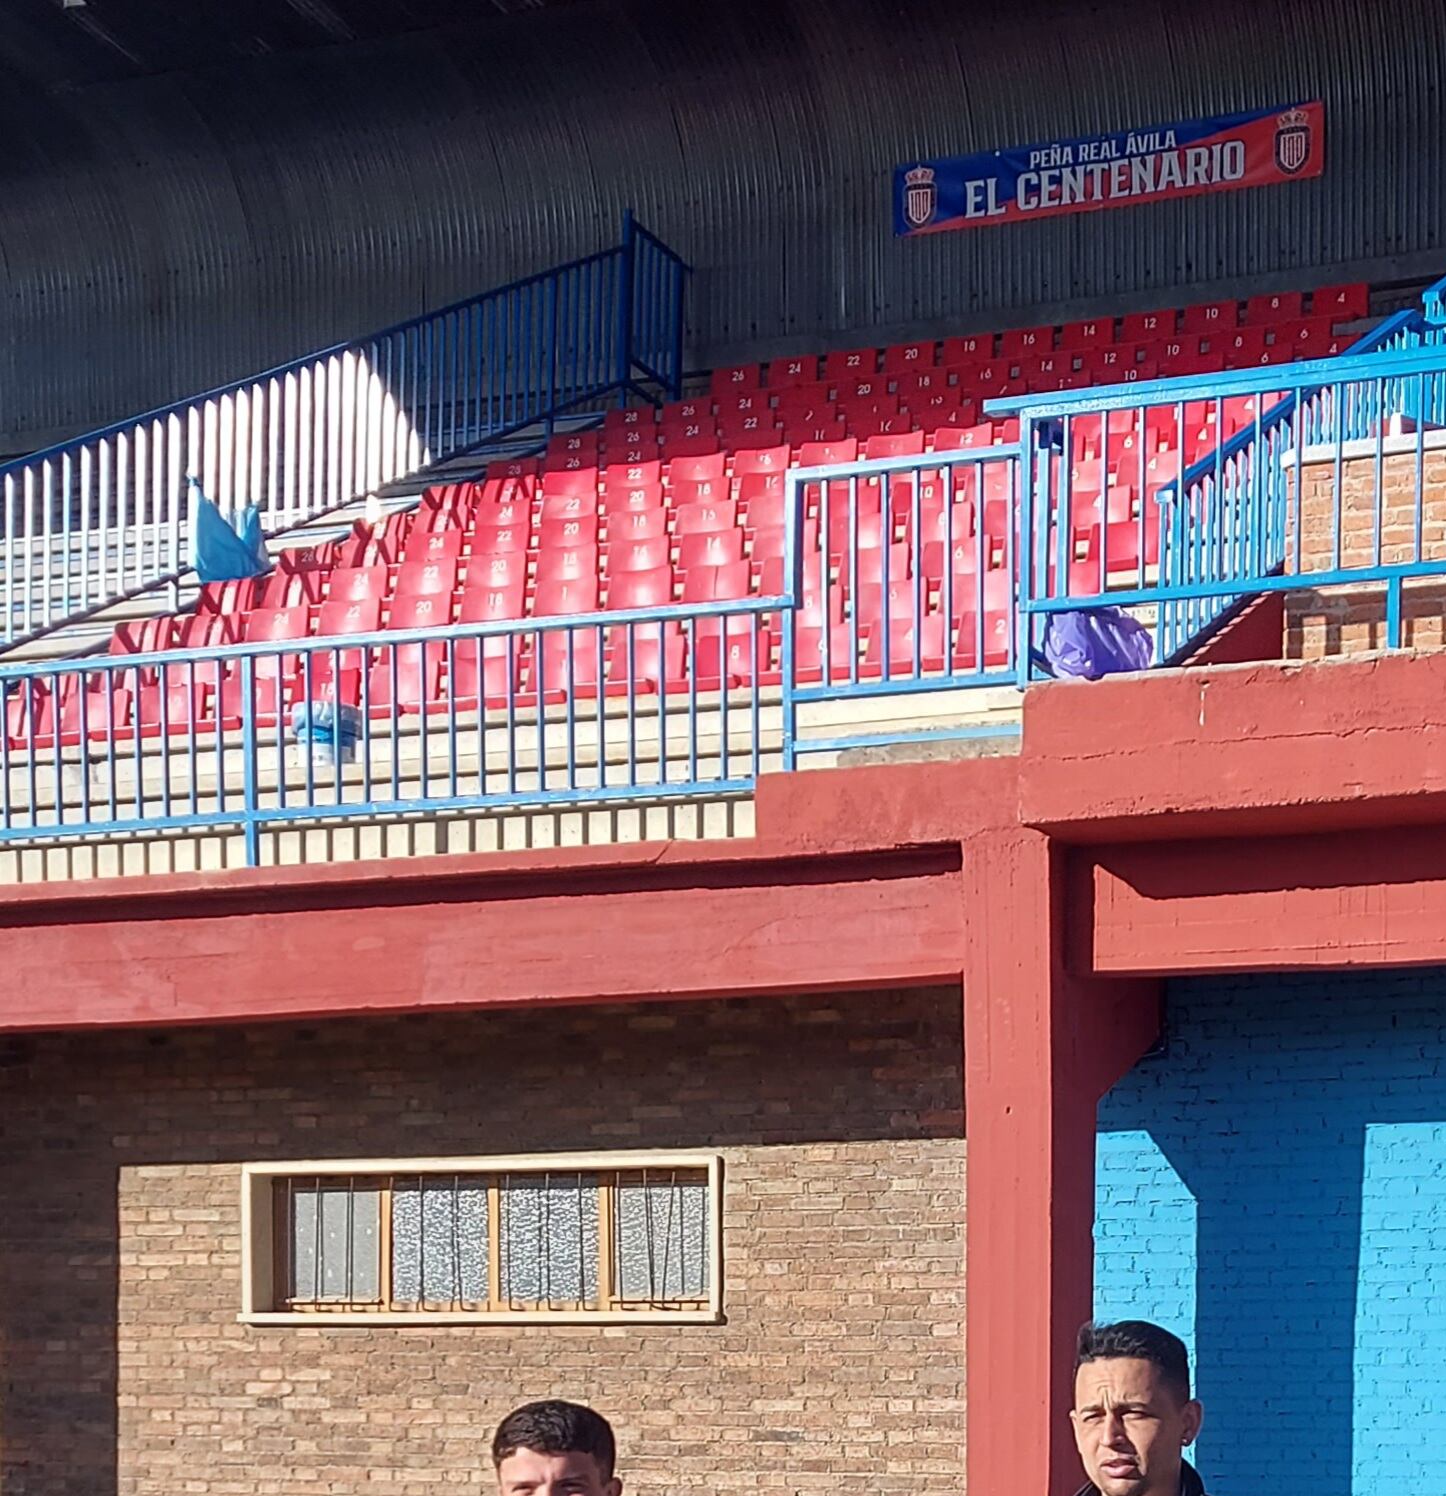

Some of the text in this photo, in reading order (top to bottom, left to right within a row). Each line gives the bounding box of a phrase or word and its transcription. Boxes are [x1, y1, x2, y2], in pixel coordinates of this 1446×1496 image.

[1029, 129, 1176, 168] PEÑA REAL ÁVILA
[964, 140, 1244, 219] EL CENTENARIO
[1271, 297, 1279, 308] 8
[1337, 293, 1345, 303] 4
[1205, 308, 1218, 319] 10
[1144, 318, 1157, 329] 12
[1083, 325, 1096, 336] 14
[1300, 328, 1308, 339] 6
[1023, 334, 1035, 345] 16
[1235, 336, 1243, 347] 8
[964, 341, 976, 352] 18
[1167, 345, 1180, 356] 10
[1329, 343, 1337, 354] 4
[904, 348, 919, 360] 20
[1104, 353, 1116, 363] 12
[1261, 353, 1269, 363] 6
[847, 355, 861, 366] 22
[1040, 360, 1053, 372] 14
[788, 363, 801, 374] 24
[732, 371, 745, 382] 26
[1124, 370, 1137, 381] 10
[918, 376, 930, 387] 18
[858, 383, 871, 395] 20
[739, 398, 752, 409] 24
[682, 405, 695, 416] 26
[625, 412, 638, 422] 28
[744, 417, 757, 429] 22
[686, 426, 699, 436] 24
[628, 432, 640, 442] 26
[1124, 436, 1132, 448] 6
[568, 439, 581, 449] 28
[628, 452, 640, 462] 24
[567, 458, 580, 468] 26
[628, 468, 642, 480] 22
[630, 490, 645, 502] 20
[564, 523, 579, 534] 20
[497, 530, 512, 542] 22
[416, 601, 432, 613] 20
[995, 619, 1006, 634] 2
[731, 644, 740, 660] 8
